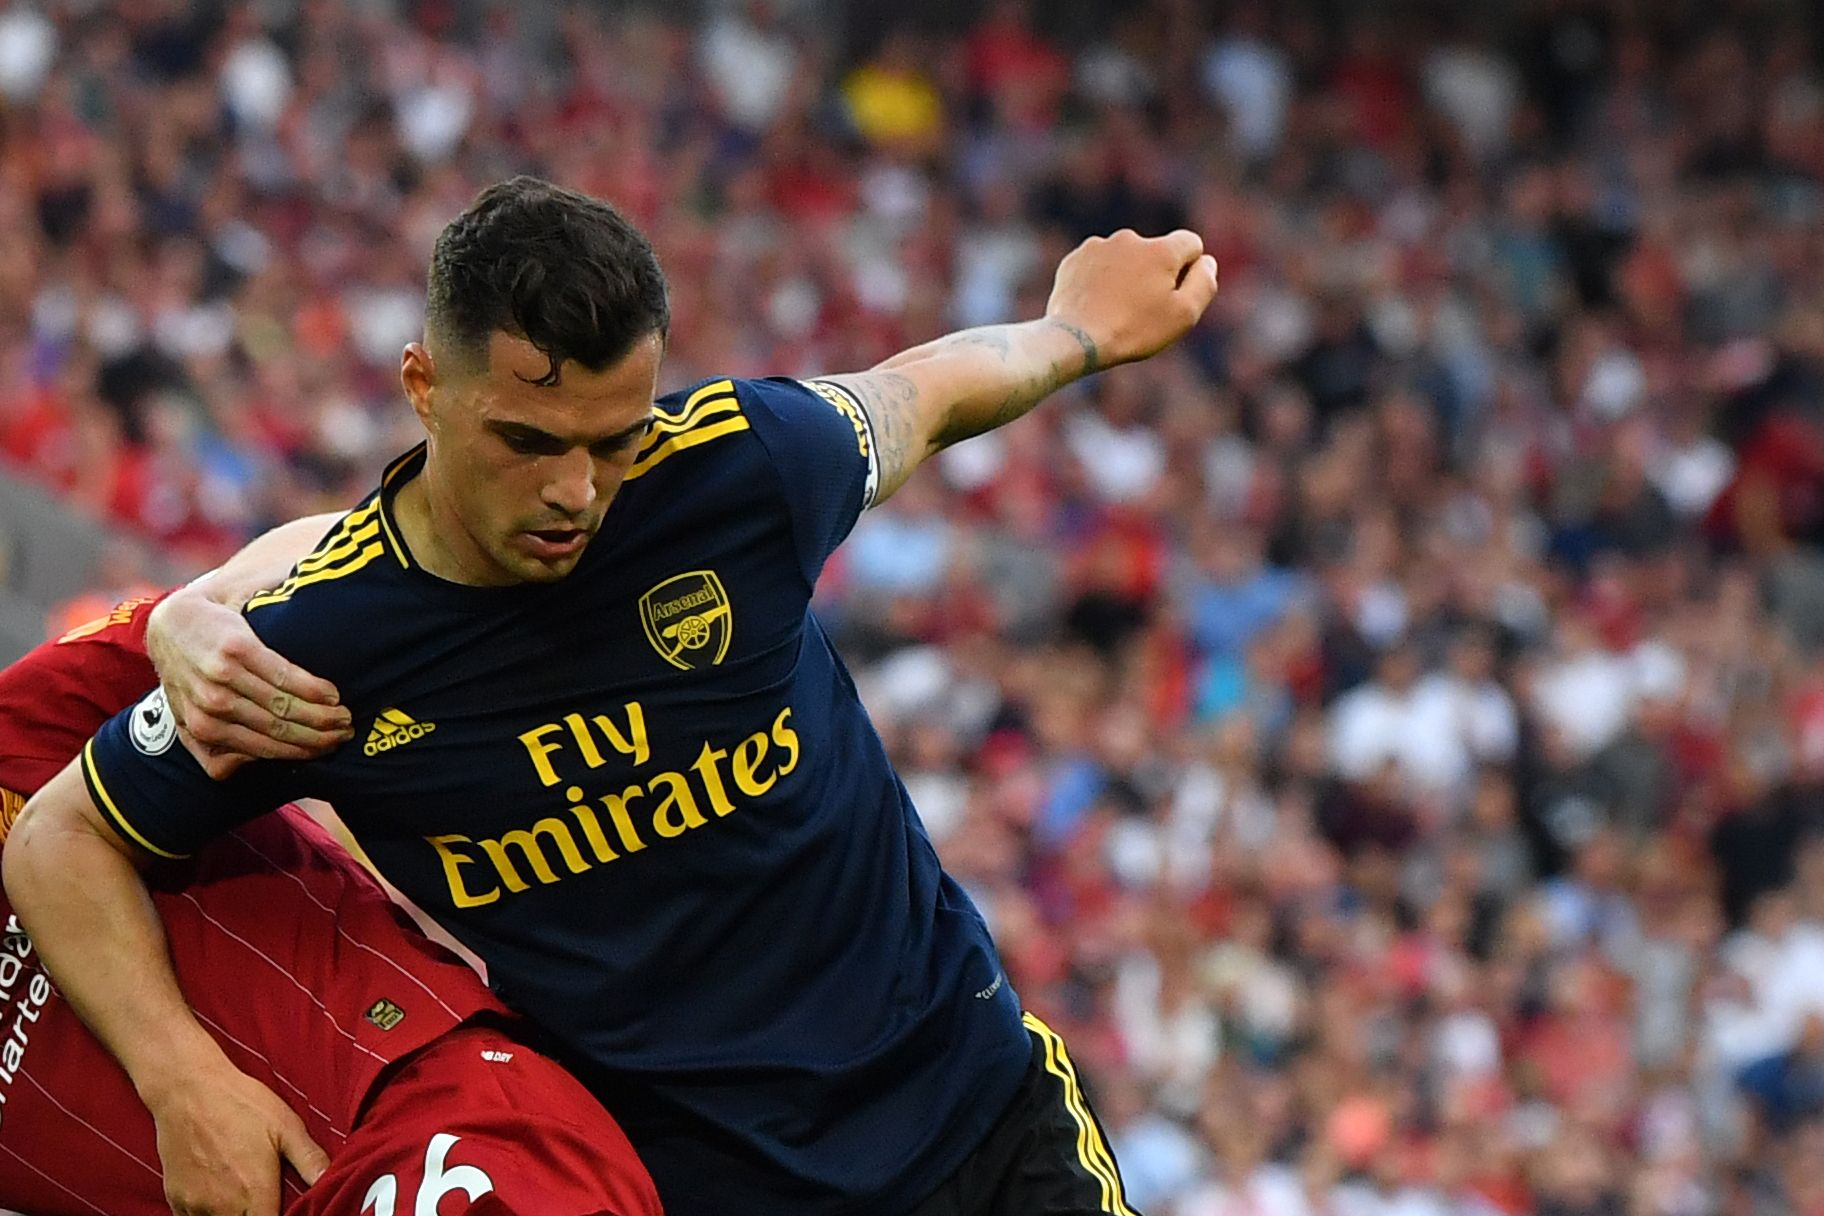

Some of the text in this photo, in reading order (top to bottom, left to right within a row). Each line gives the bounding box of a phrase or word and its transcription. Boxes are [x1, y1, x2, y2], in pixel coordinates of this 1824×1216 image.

[653, 584, 714, 622] Arsenal
[363, 722, 436, 757] adidas
[517, 701, 651, 787] Fly
[422, 706, 800, 909] Emirates
